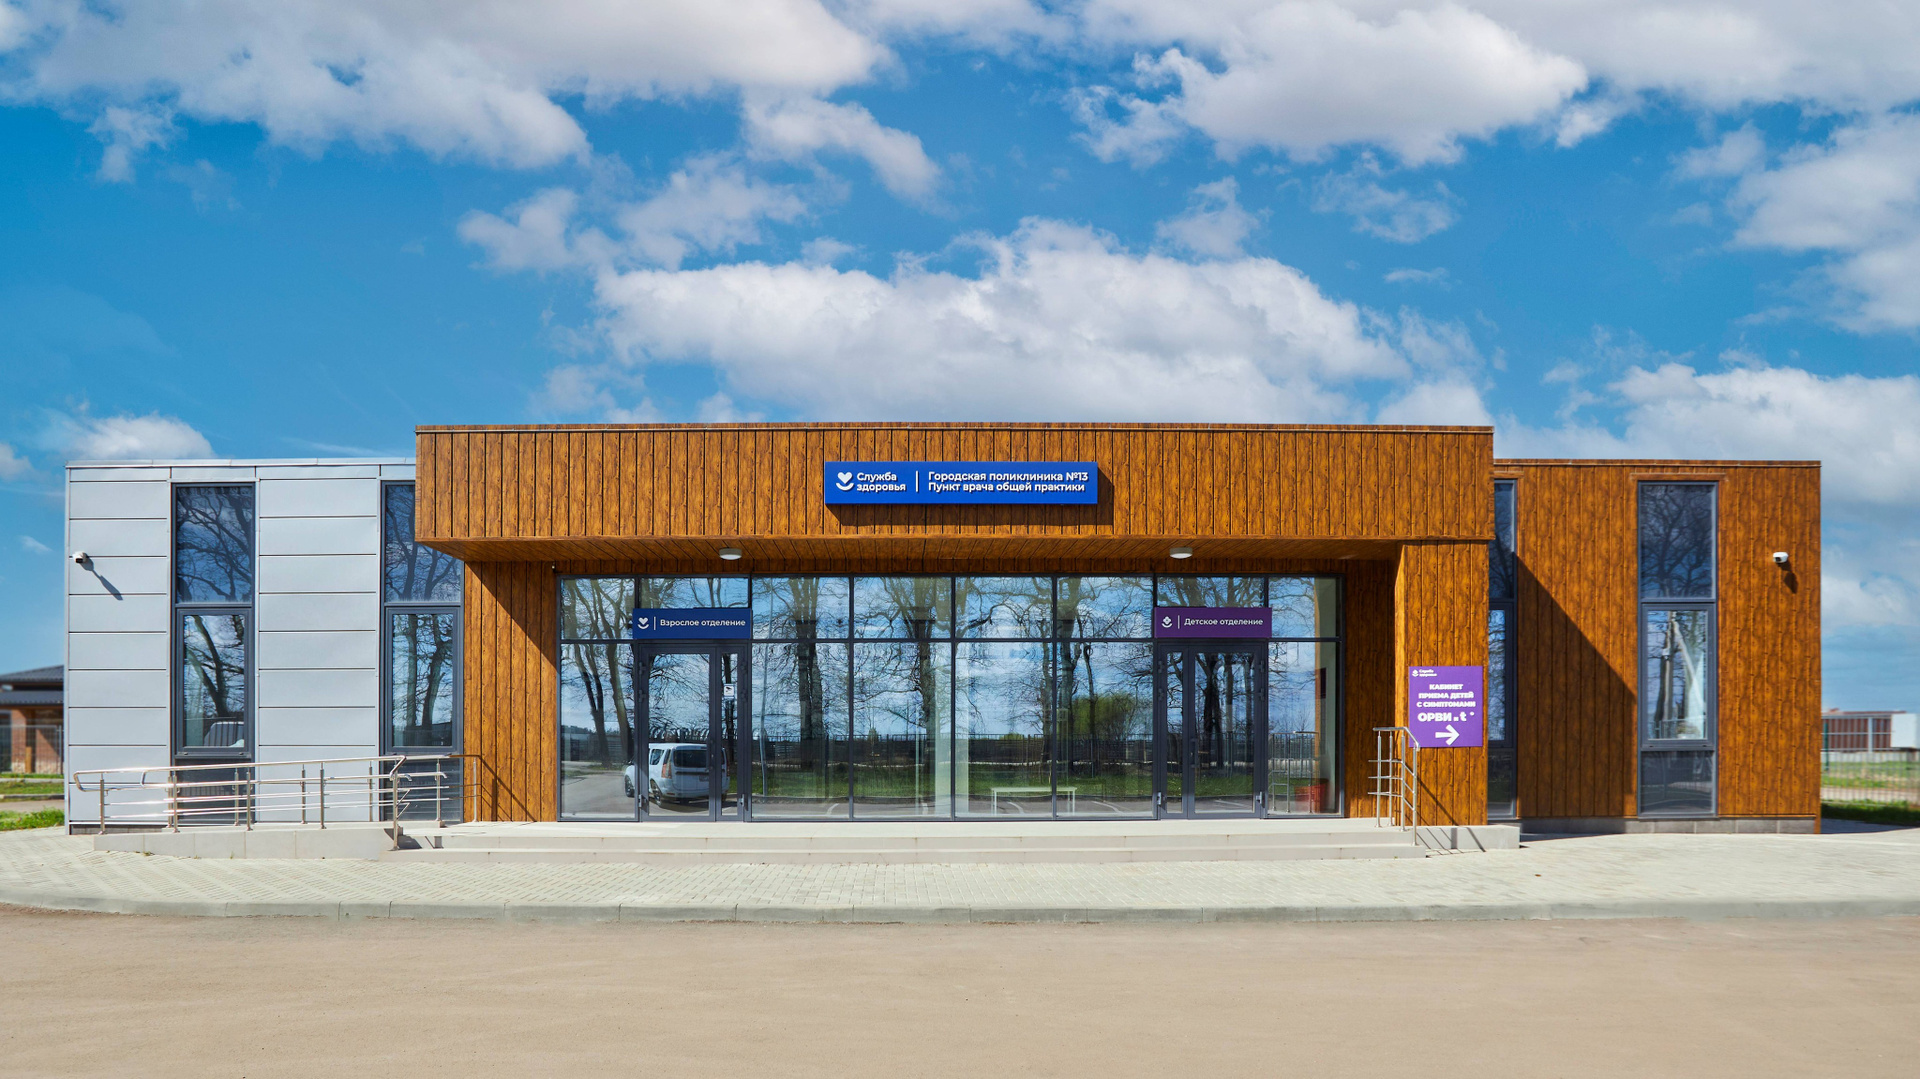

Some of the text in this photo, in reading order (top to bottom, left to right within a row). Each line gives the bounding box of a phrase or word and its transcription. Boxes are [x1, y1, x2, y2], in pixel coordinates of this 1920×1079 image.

[856, 472, 897, 482] Служба
[928, 471, 1088, 483] Городская поликлиника №13
[856, 484, 906, 492] здоровья
[928, 482, 1085, 493] Пункт врача общей практики
[660, 619, 700, 628] Взрослое
[1184, 618, 1218, 626] Детское
[1450, 691, 1474, 699] ДЕТЕЙ
[1417, 712, 1452, 722] ОРВИ
